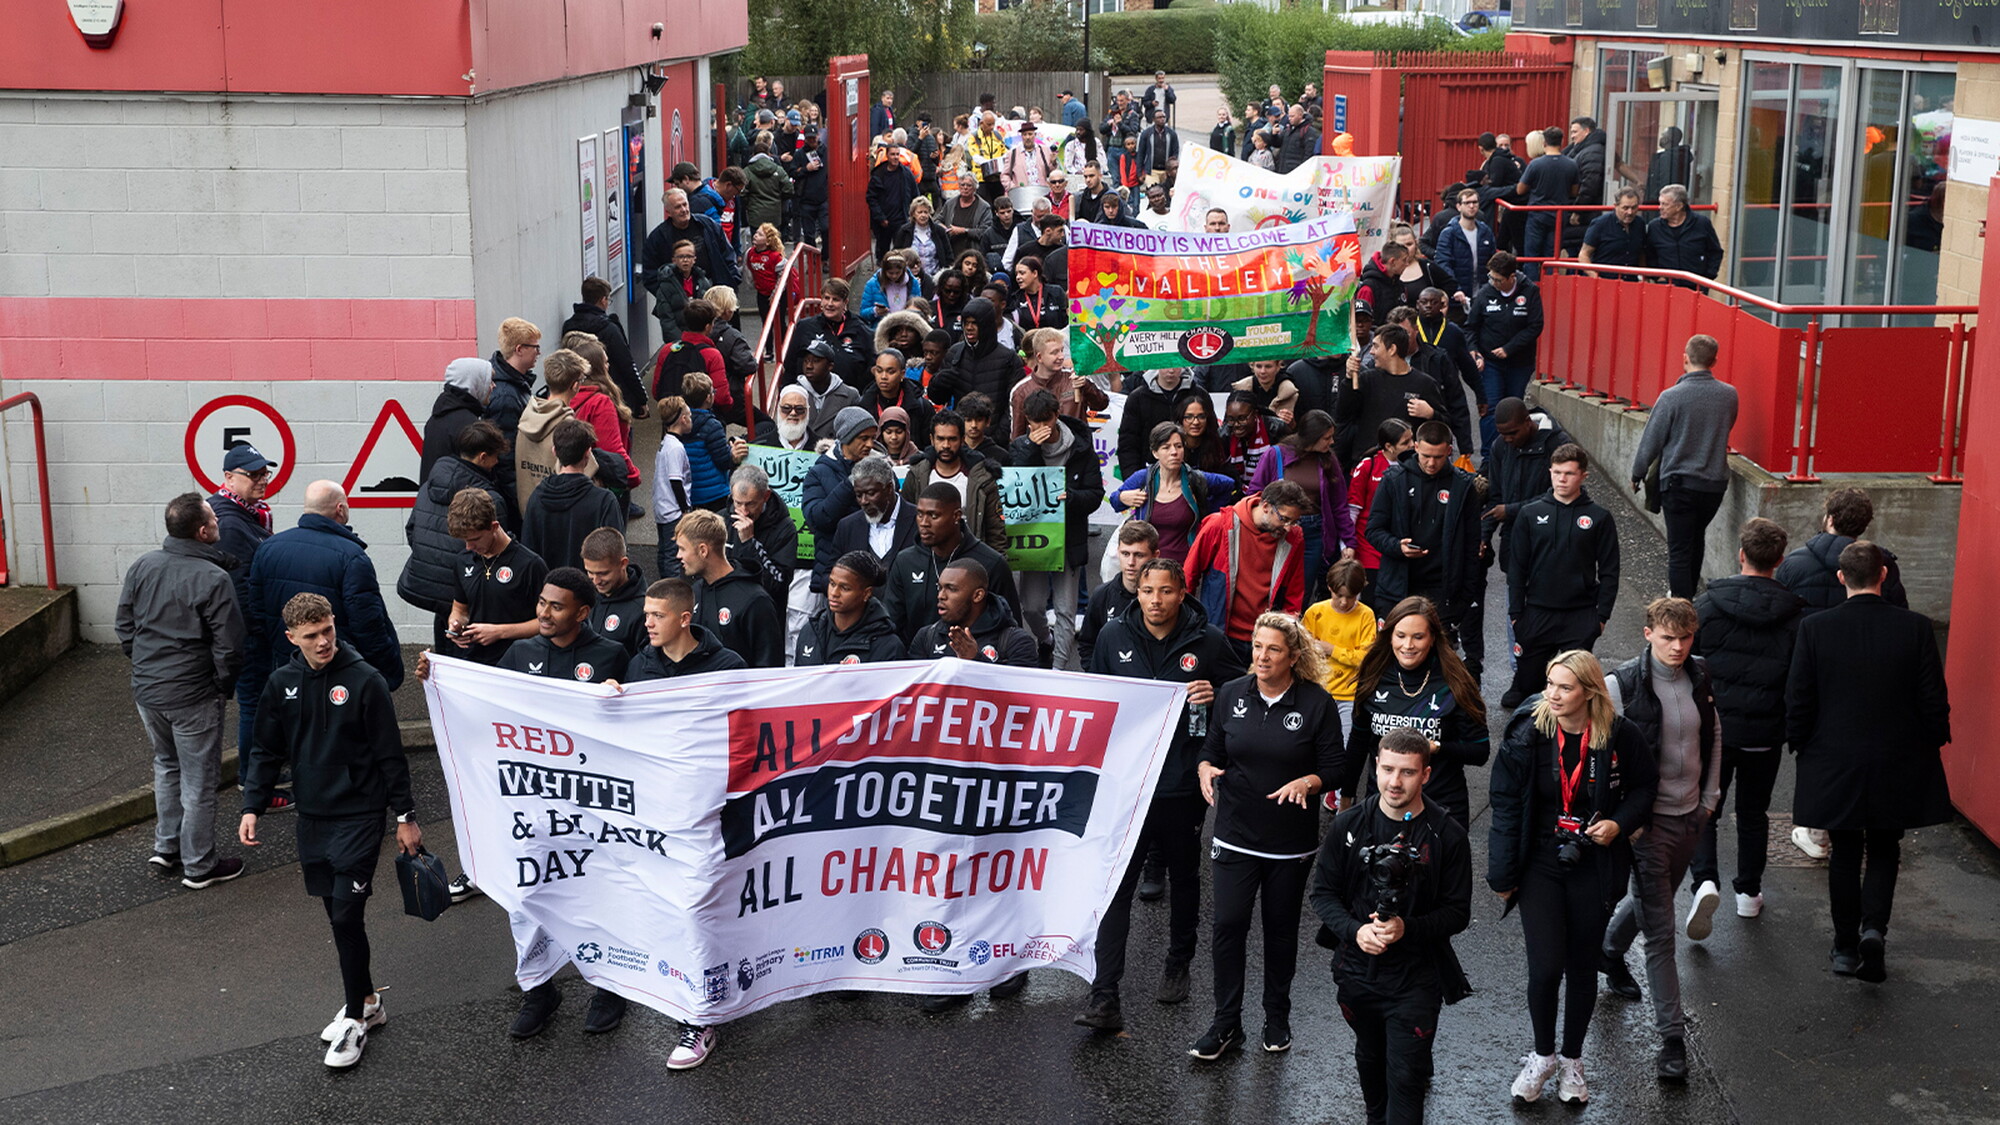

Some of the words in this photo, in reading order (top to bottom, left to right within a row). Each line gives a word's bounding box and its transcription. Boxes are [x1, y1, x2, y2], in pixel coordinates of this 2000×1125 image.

[1071, 227, 1167, 252] EVERYBODY
[1173, 236, 1189, 252] IS
[1193, 228, 1290, 252] WELCOME
[1306, 220, 1328, 240] AT
[1180, 255, 1231, 270] THE
[1136, 266, 1284, 296] VALLEY
[1129, 332, 1157, 344] AVERY
[1160, 330, 1178, 341] HILL
[1185, 326, 1226, 338] CHARLTON
[1247, 324, 1280, 336] YOUNG
[1135, 342, 1164, 354] YOUTH
[1427, 718, 1441, 729] OF
[751, 718, 821, 773] ALL
[836, 695, 1094, 753] DIFFERENT
[491, 722, 587, 766] RED,
[498, 763, 633, 813] WHITE
[752, 787, 814, 844] ALL
[833, 771, 1065, 828] TOGETHER
[512, 811, 536, 841] &
[546, 809, 670, 859] BLACK
[516, 849, 594, 888] DAY
[736, 856, 803, 918] ALL
[820, 846, 1049, 901] CHARLTON
[607, 945, 650, 960] Professional
[810, 945, 845, 961] ITRM
[993, 943, 1018, 959] EFL
[606, 959, 647, 973] Association
[755, 954, 785, 972] Primary
[670, 967, 684, 981] EFL
